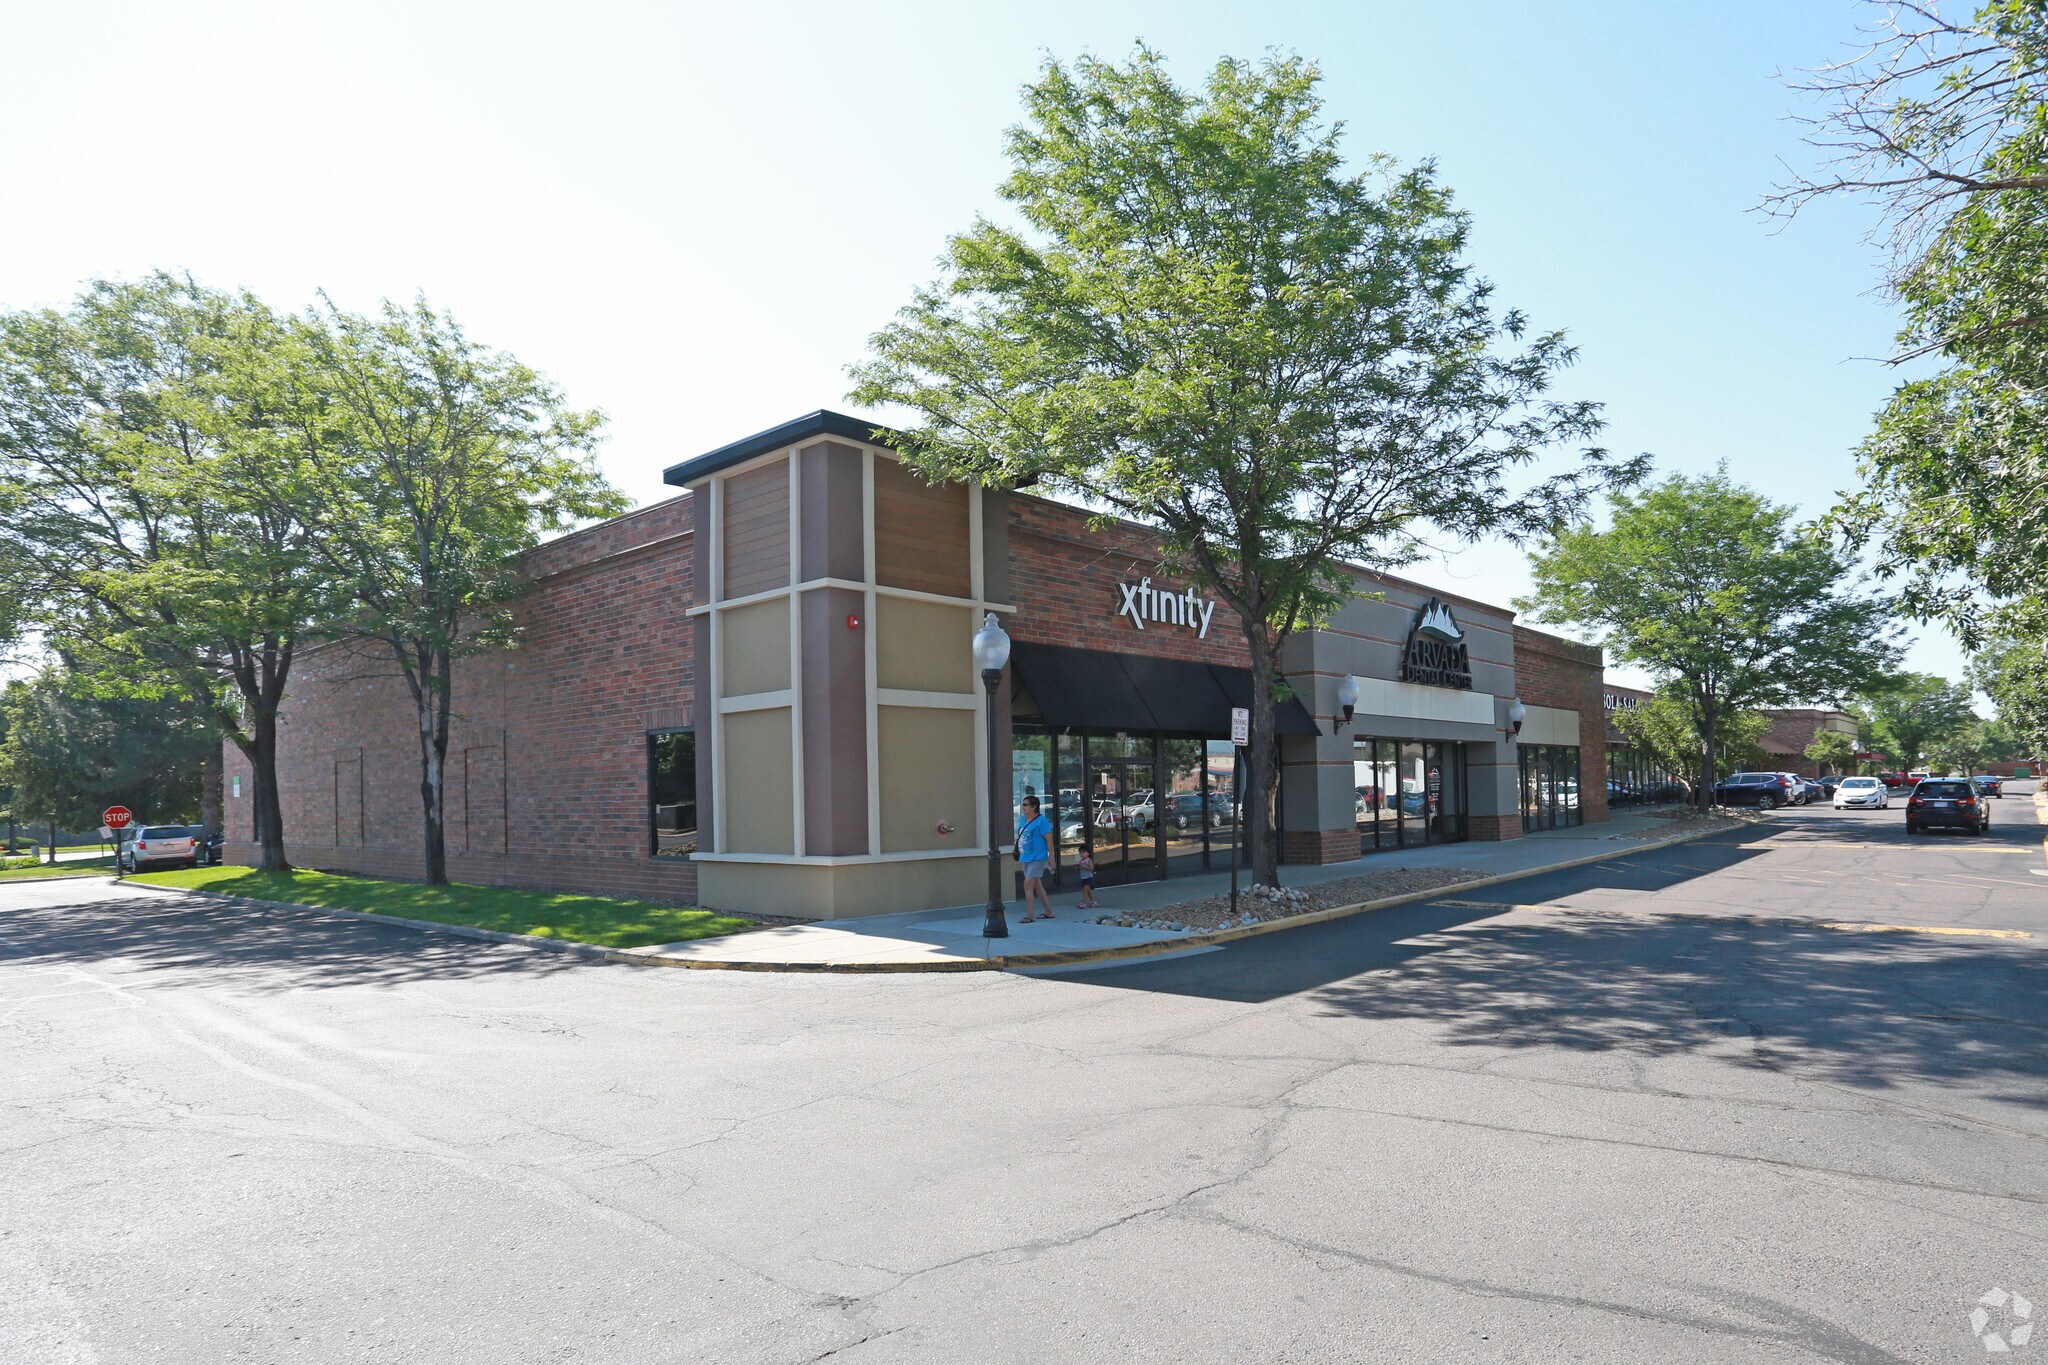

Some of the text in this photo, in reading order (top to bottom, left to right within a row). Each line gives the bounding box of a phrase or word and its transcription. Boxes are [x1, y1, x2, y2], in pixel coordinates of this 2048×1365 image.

[1119, 576, 1216, 639] xfinity
[1406, 635, 1472, 673] ARVADA
[1407, 666, 1472, 690] DENTAL CENTER
[105, 812, 129, 822] STOP
